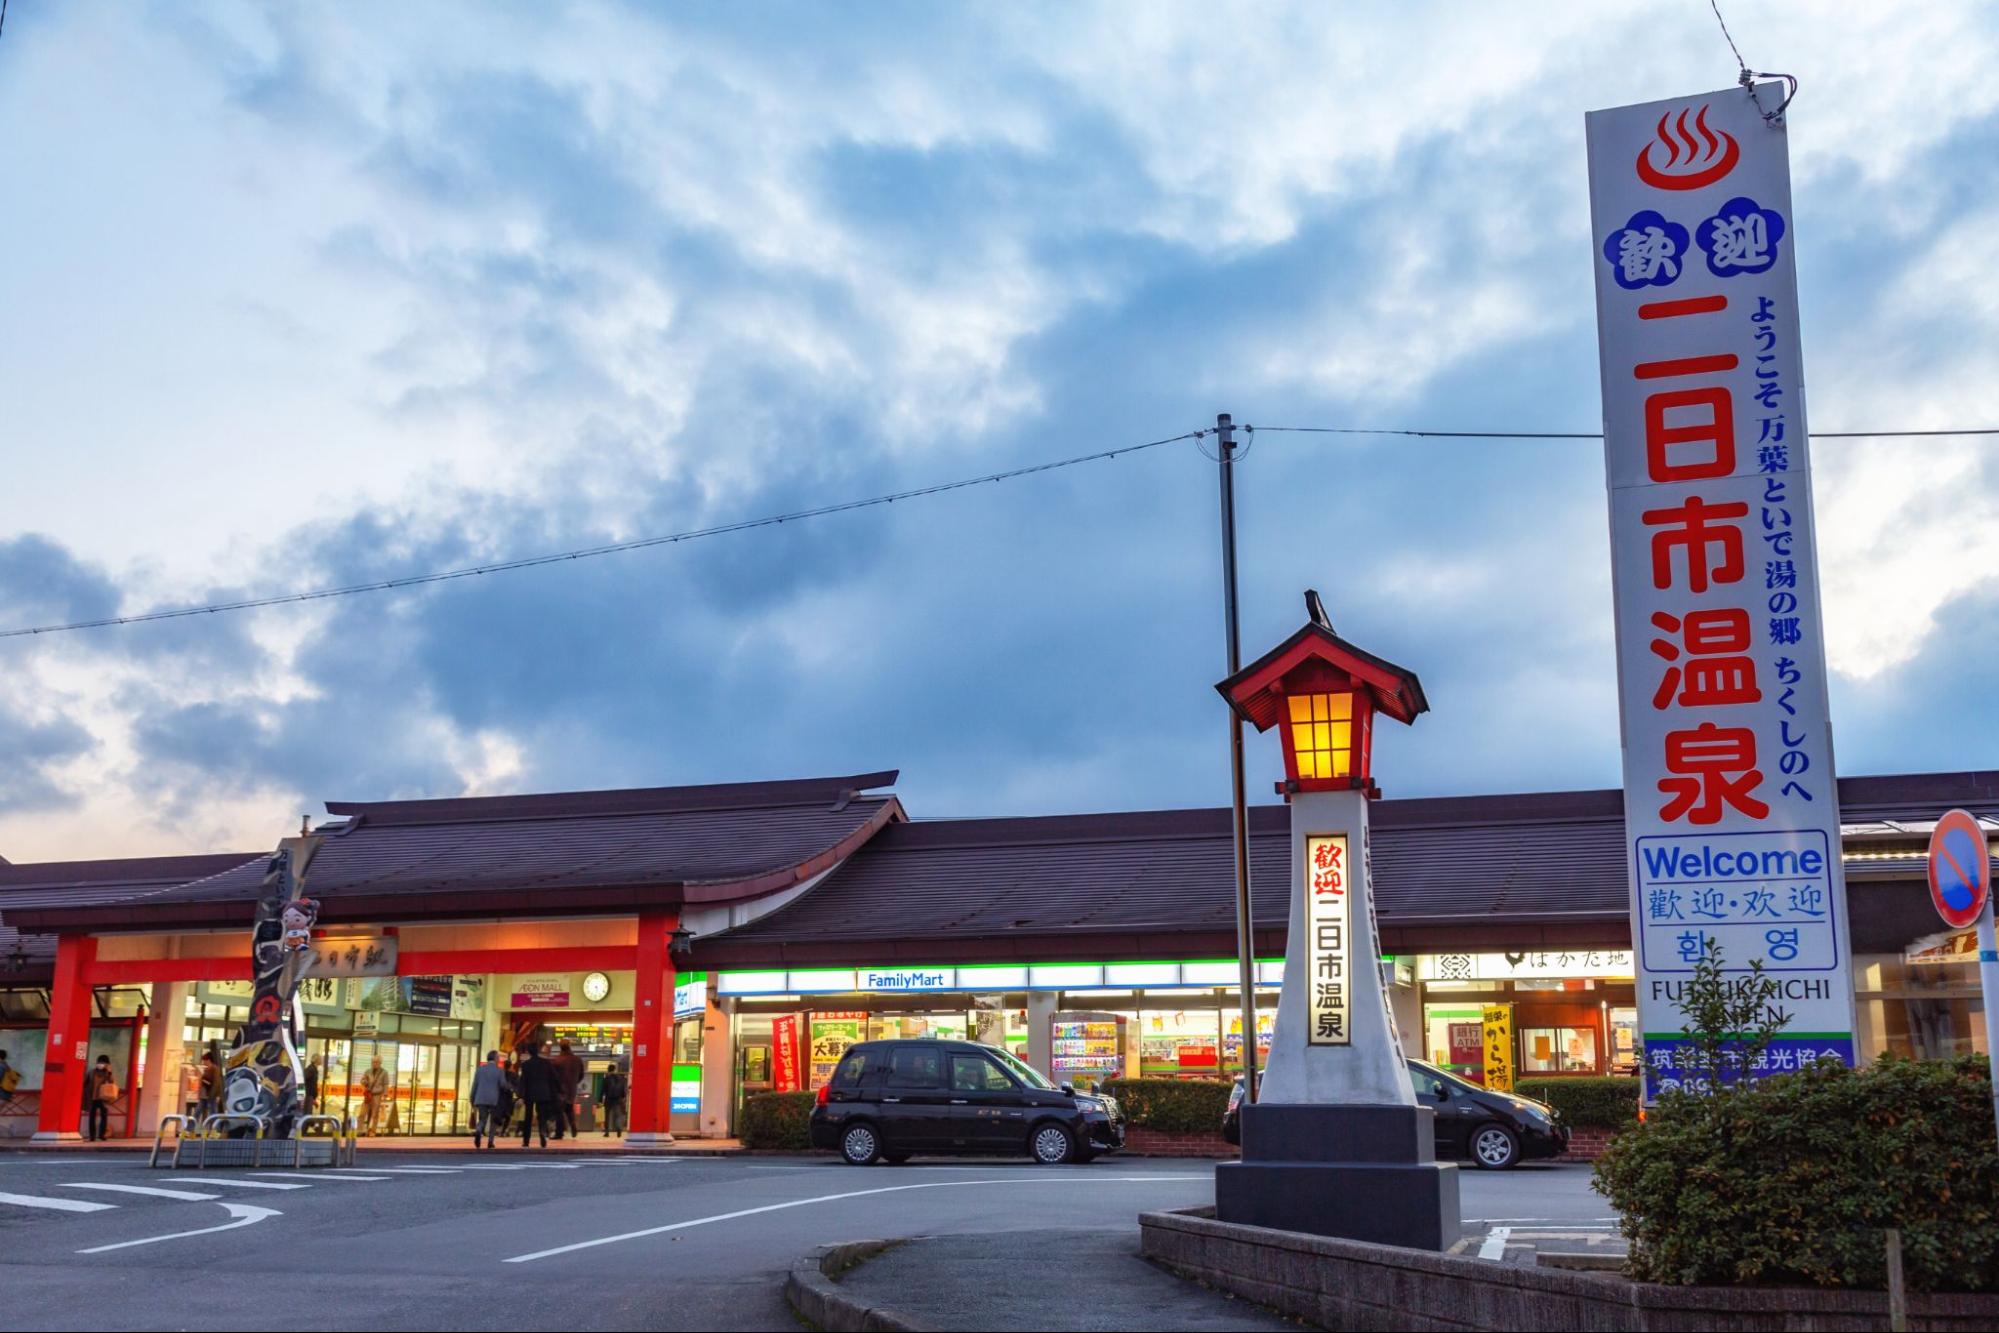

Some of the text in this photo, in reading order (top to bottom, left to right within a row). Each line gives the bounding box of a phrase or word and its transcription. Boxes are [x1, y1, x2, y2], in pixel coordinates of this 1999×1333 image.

[1619, 213, 1770, 281] 歓迎
[1634, 295, 1769, 824] 二日市温泉
[1751, 296, 1783, 408] ようこそ
[1774, 656, 1813, 801] ちくしのへ
[1643, 846, 1822, 879] Welcome
[1314, 844, 1344, 1038] 歓迎 二日市温泉
[541, 983, 563, 991] MALL
[868, 973, 944, 989] FamilyMart
[1652, 979, 1830, 1000] FUTUKAICHI
[1457, 1038, 1480, 1046] ATM
